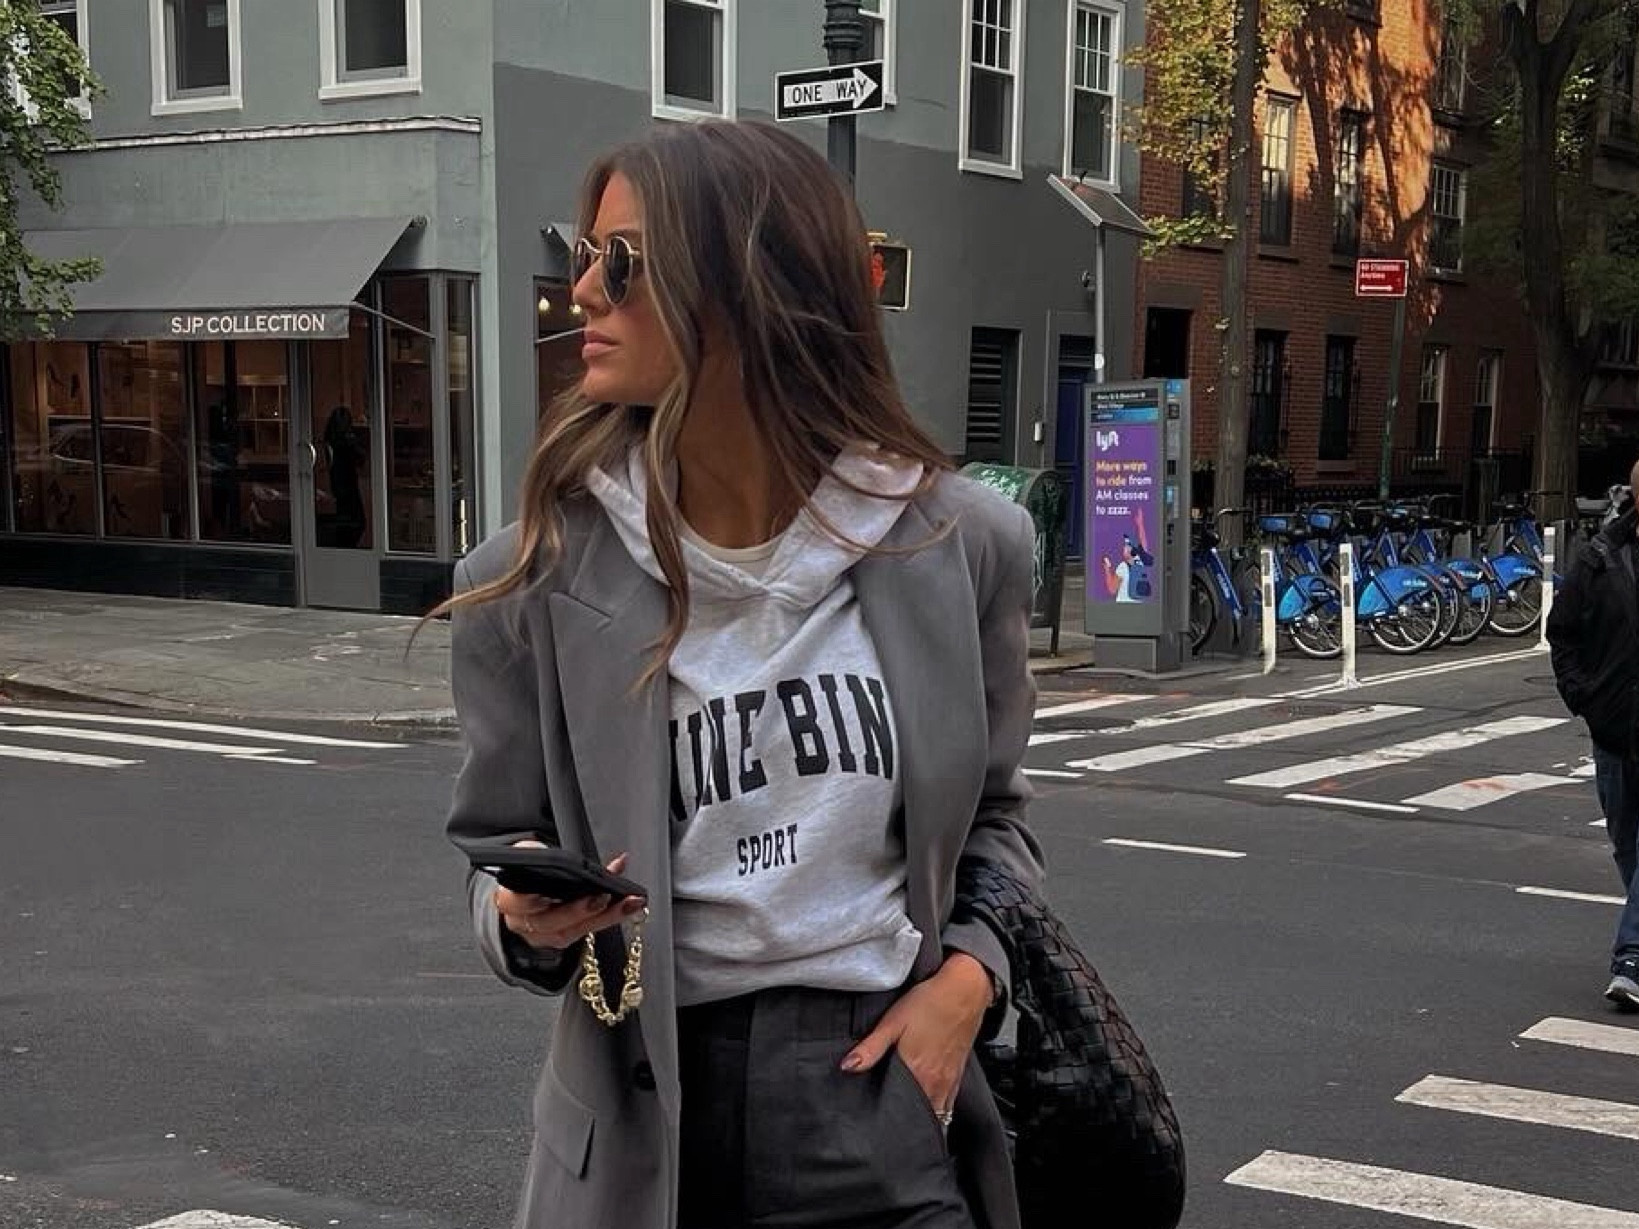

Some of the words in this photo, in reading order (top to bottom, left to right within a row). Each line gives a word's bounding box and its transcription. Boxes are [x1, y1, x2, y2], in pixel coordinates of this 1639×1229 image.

[792, 85, 823, 103] ONE
[836, 79, 868, 99] WAY
[171, 316, 204, 334] SJP
[207, 314, 326, 333] COLLECTION
[1096, 430, 1119, 452] lyft
[1128, 474, 1152, 486] from
[1096, 490, 1112, 500] AM
[1113, 488, 1148, 501] classes
[1096, 504, 1106, 515] to
[776, 673, 894, 780] BIN
[736, 823, 798, 876] SPORT
